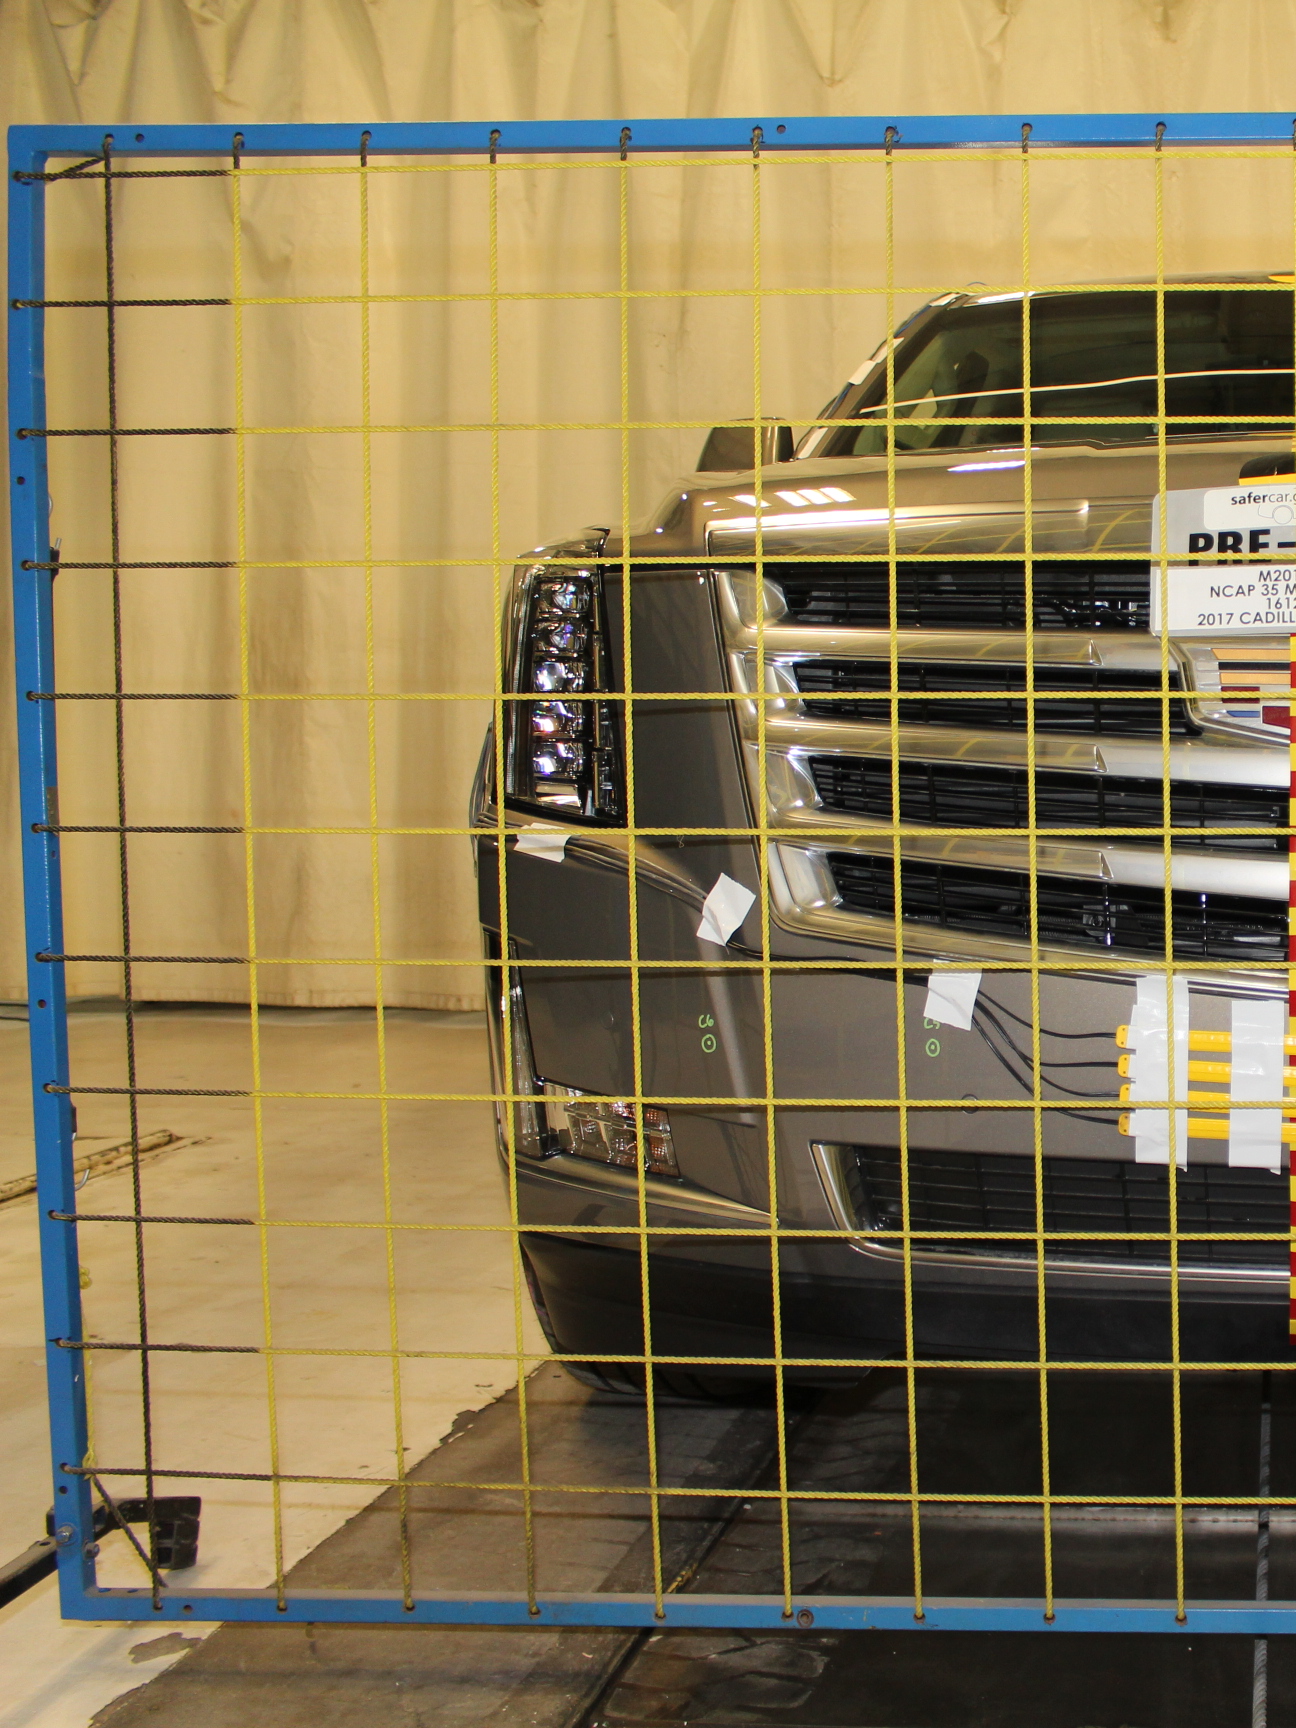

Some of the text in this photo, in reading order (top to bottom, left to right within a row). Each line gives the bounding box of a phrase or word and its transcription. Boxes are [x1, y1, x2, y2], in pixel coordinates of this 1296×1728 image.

[1210, 584, 1256, 598] NCAP
[1261, 583, 1279, 596] 35
[1197, 612, 1234, 626] 2017
[698, 1013, 715, 1029] C6
